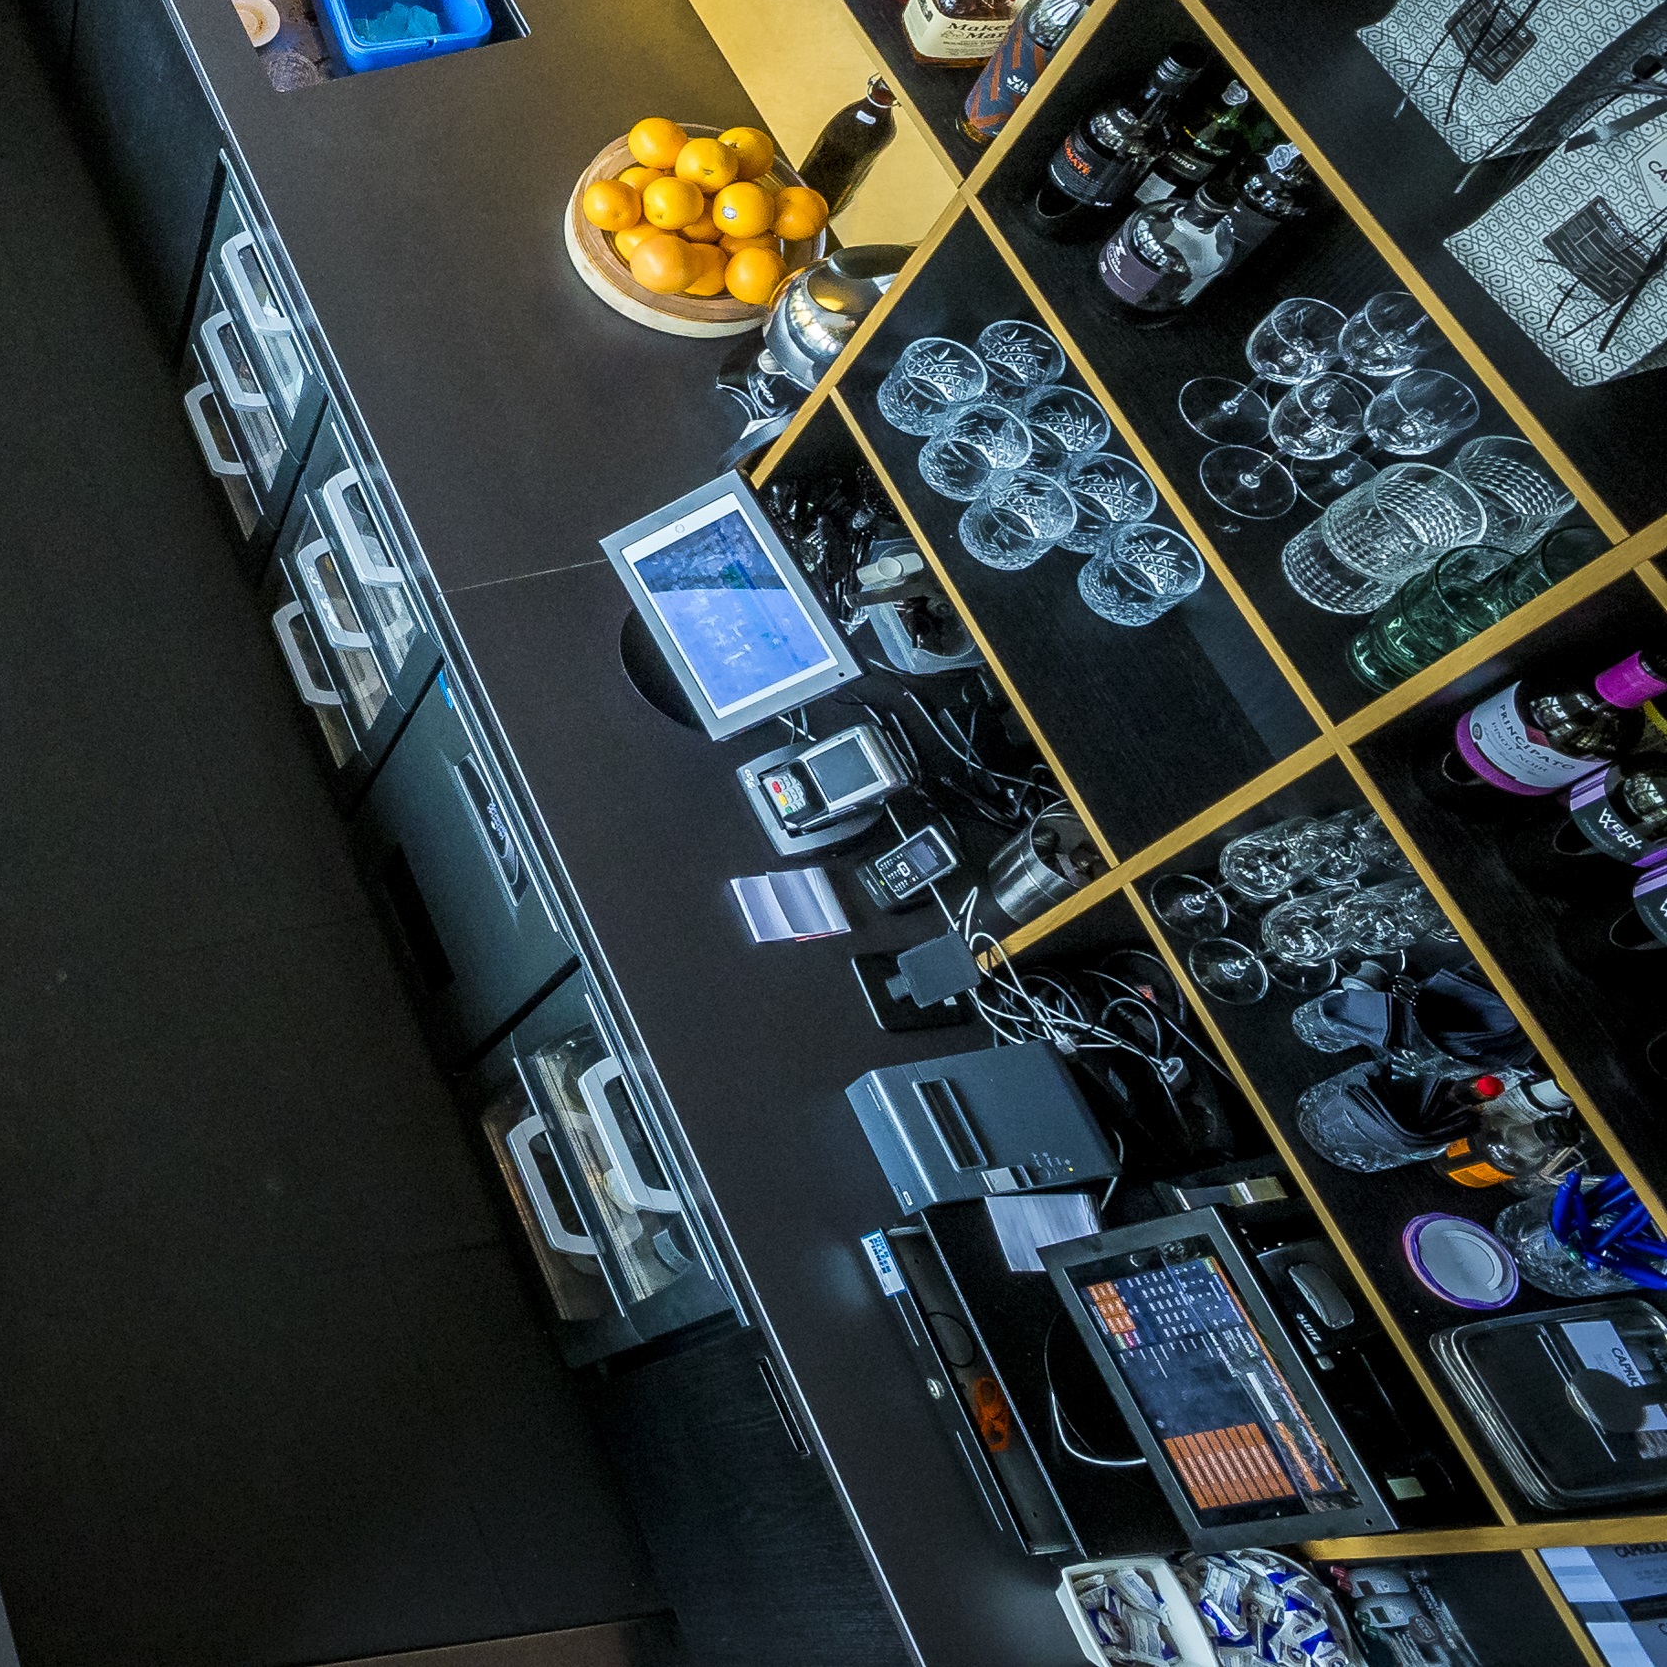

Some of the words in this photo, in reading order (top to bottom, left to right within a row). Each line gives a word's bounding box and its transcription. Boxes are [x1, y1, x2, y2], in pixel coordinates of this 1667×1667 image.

[965, 30, 1007, 40] Mar
[1595, 202, 1609, 222] WE
[1499, 703, 1576, 771] PRINCIPATO
